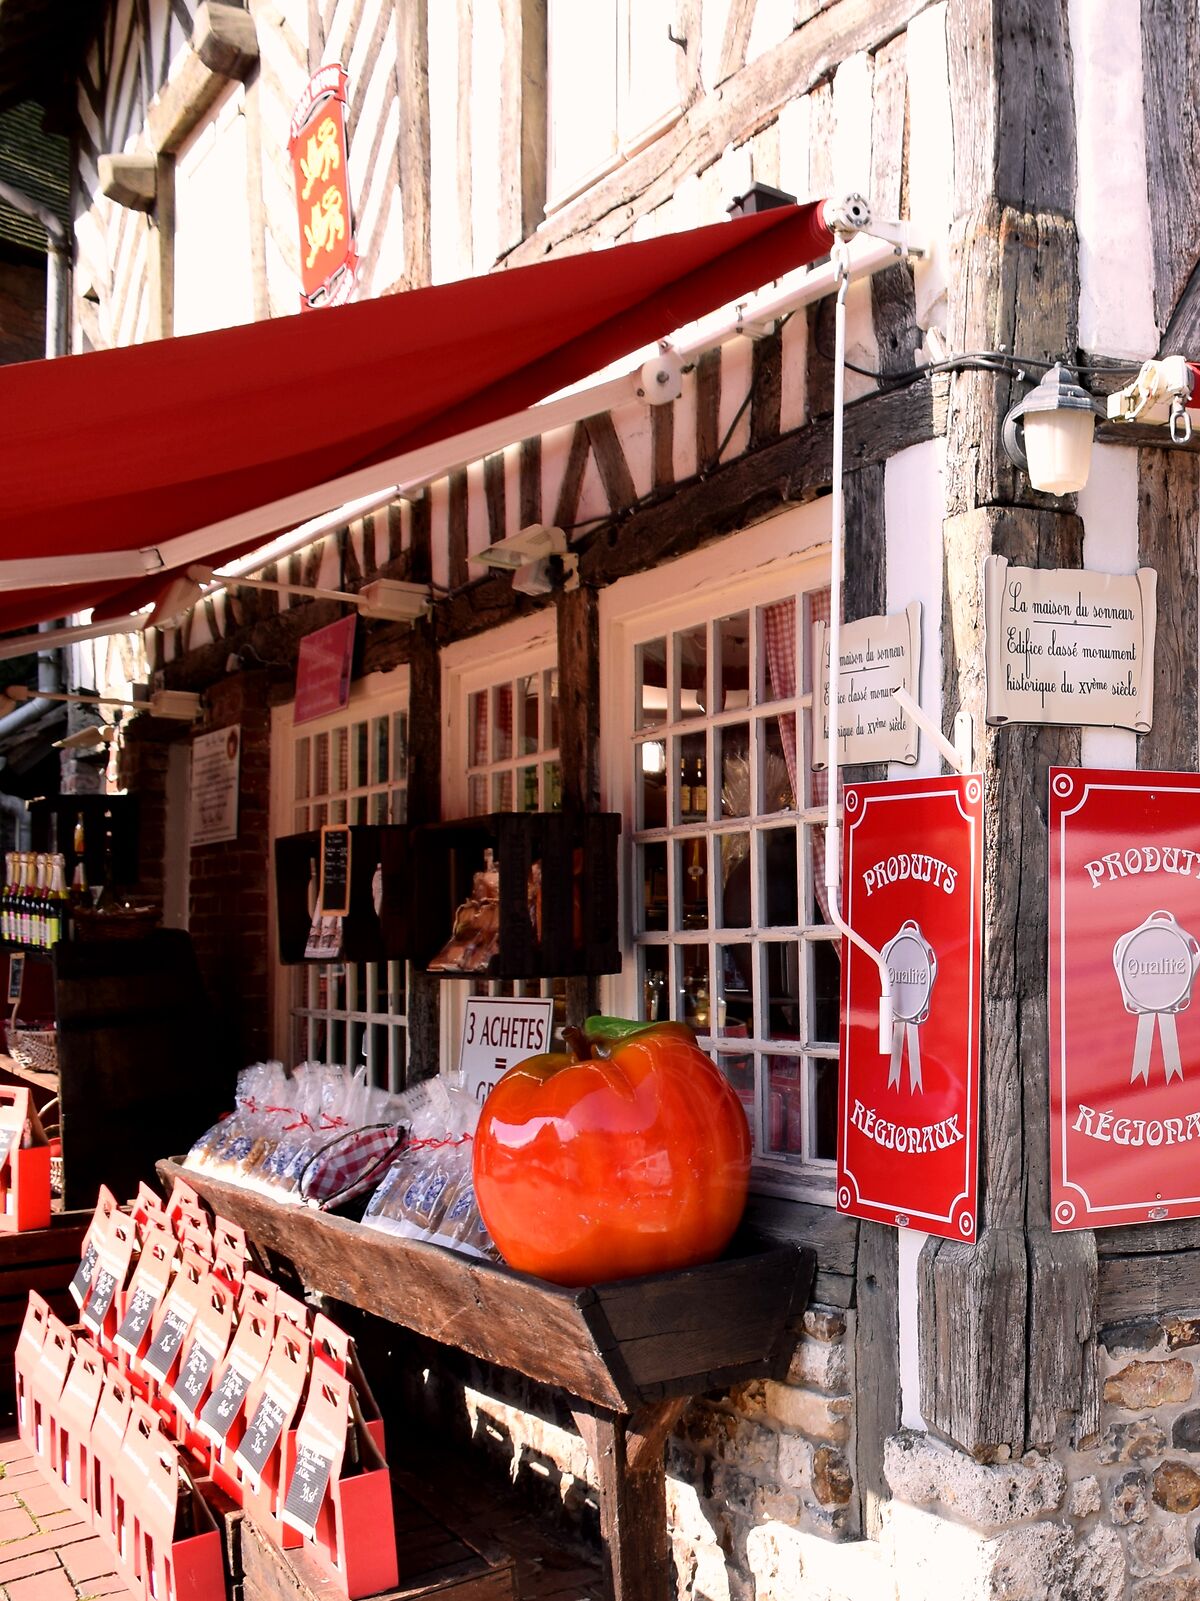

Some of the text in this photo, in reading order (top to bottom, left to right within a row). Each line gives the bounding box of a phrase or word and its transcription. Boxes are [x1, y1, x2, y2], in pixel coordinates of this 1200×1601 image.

[1008, 581, 1135, 621] La maison du sonneur
[840, 650, 863, 667] maison
[866, 638, 874, 662] du
[877, 645, 905, 660] sonneur
[1007, 626, 1136, 679] Edifice classé monument
[1006, 664, 1056, 708] historique
[1061, 671, 1074, 693] du
[1112, 670, 1137, 697] siècle
[856, 714, 864, 735] du
[862, 853, 959, 897] PRODUITS
[1127, 957, 1186, 978] Qualité
[466, 1011, 545, 1051] 3 ACHETES
[850, 1098, 964, 1154] RÉGIONAUX
